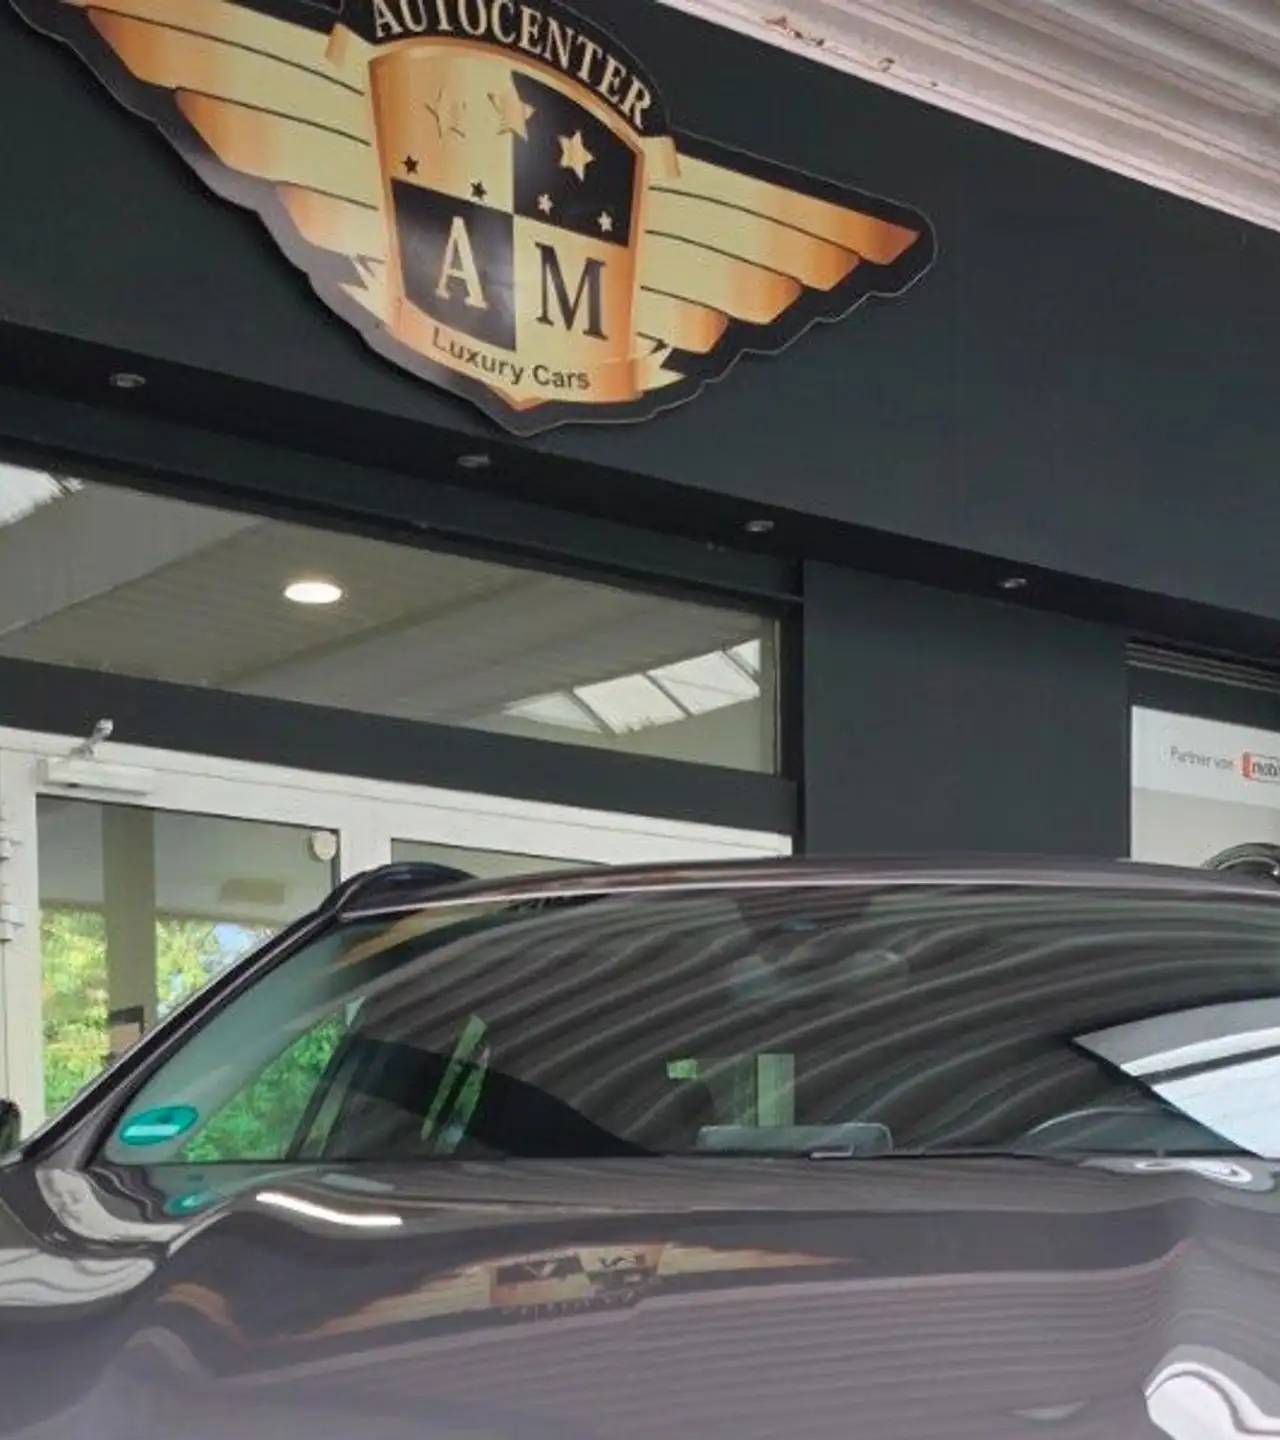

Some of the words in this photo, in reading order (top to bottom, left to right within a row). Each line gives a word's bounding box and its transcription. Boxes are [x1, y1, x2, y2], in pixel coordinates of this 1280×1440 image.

[375, 0, 652, 128] AUTOCENTER
[435, 216, 488, 309] A
[535, 241, 608, 341] M
[433, 326, 524, 386] Luxury
[532, 363, 591, 391] Cars
[1170, 745, 1211, 769] Partner
